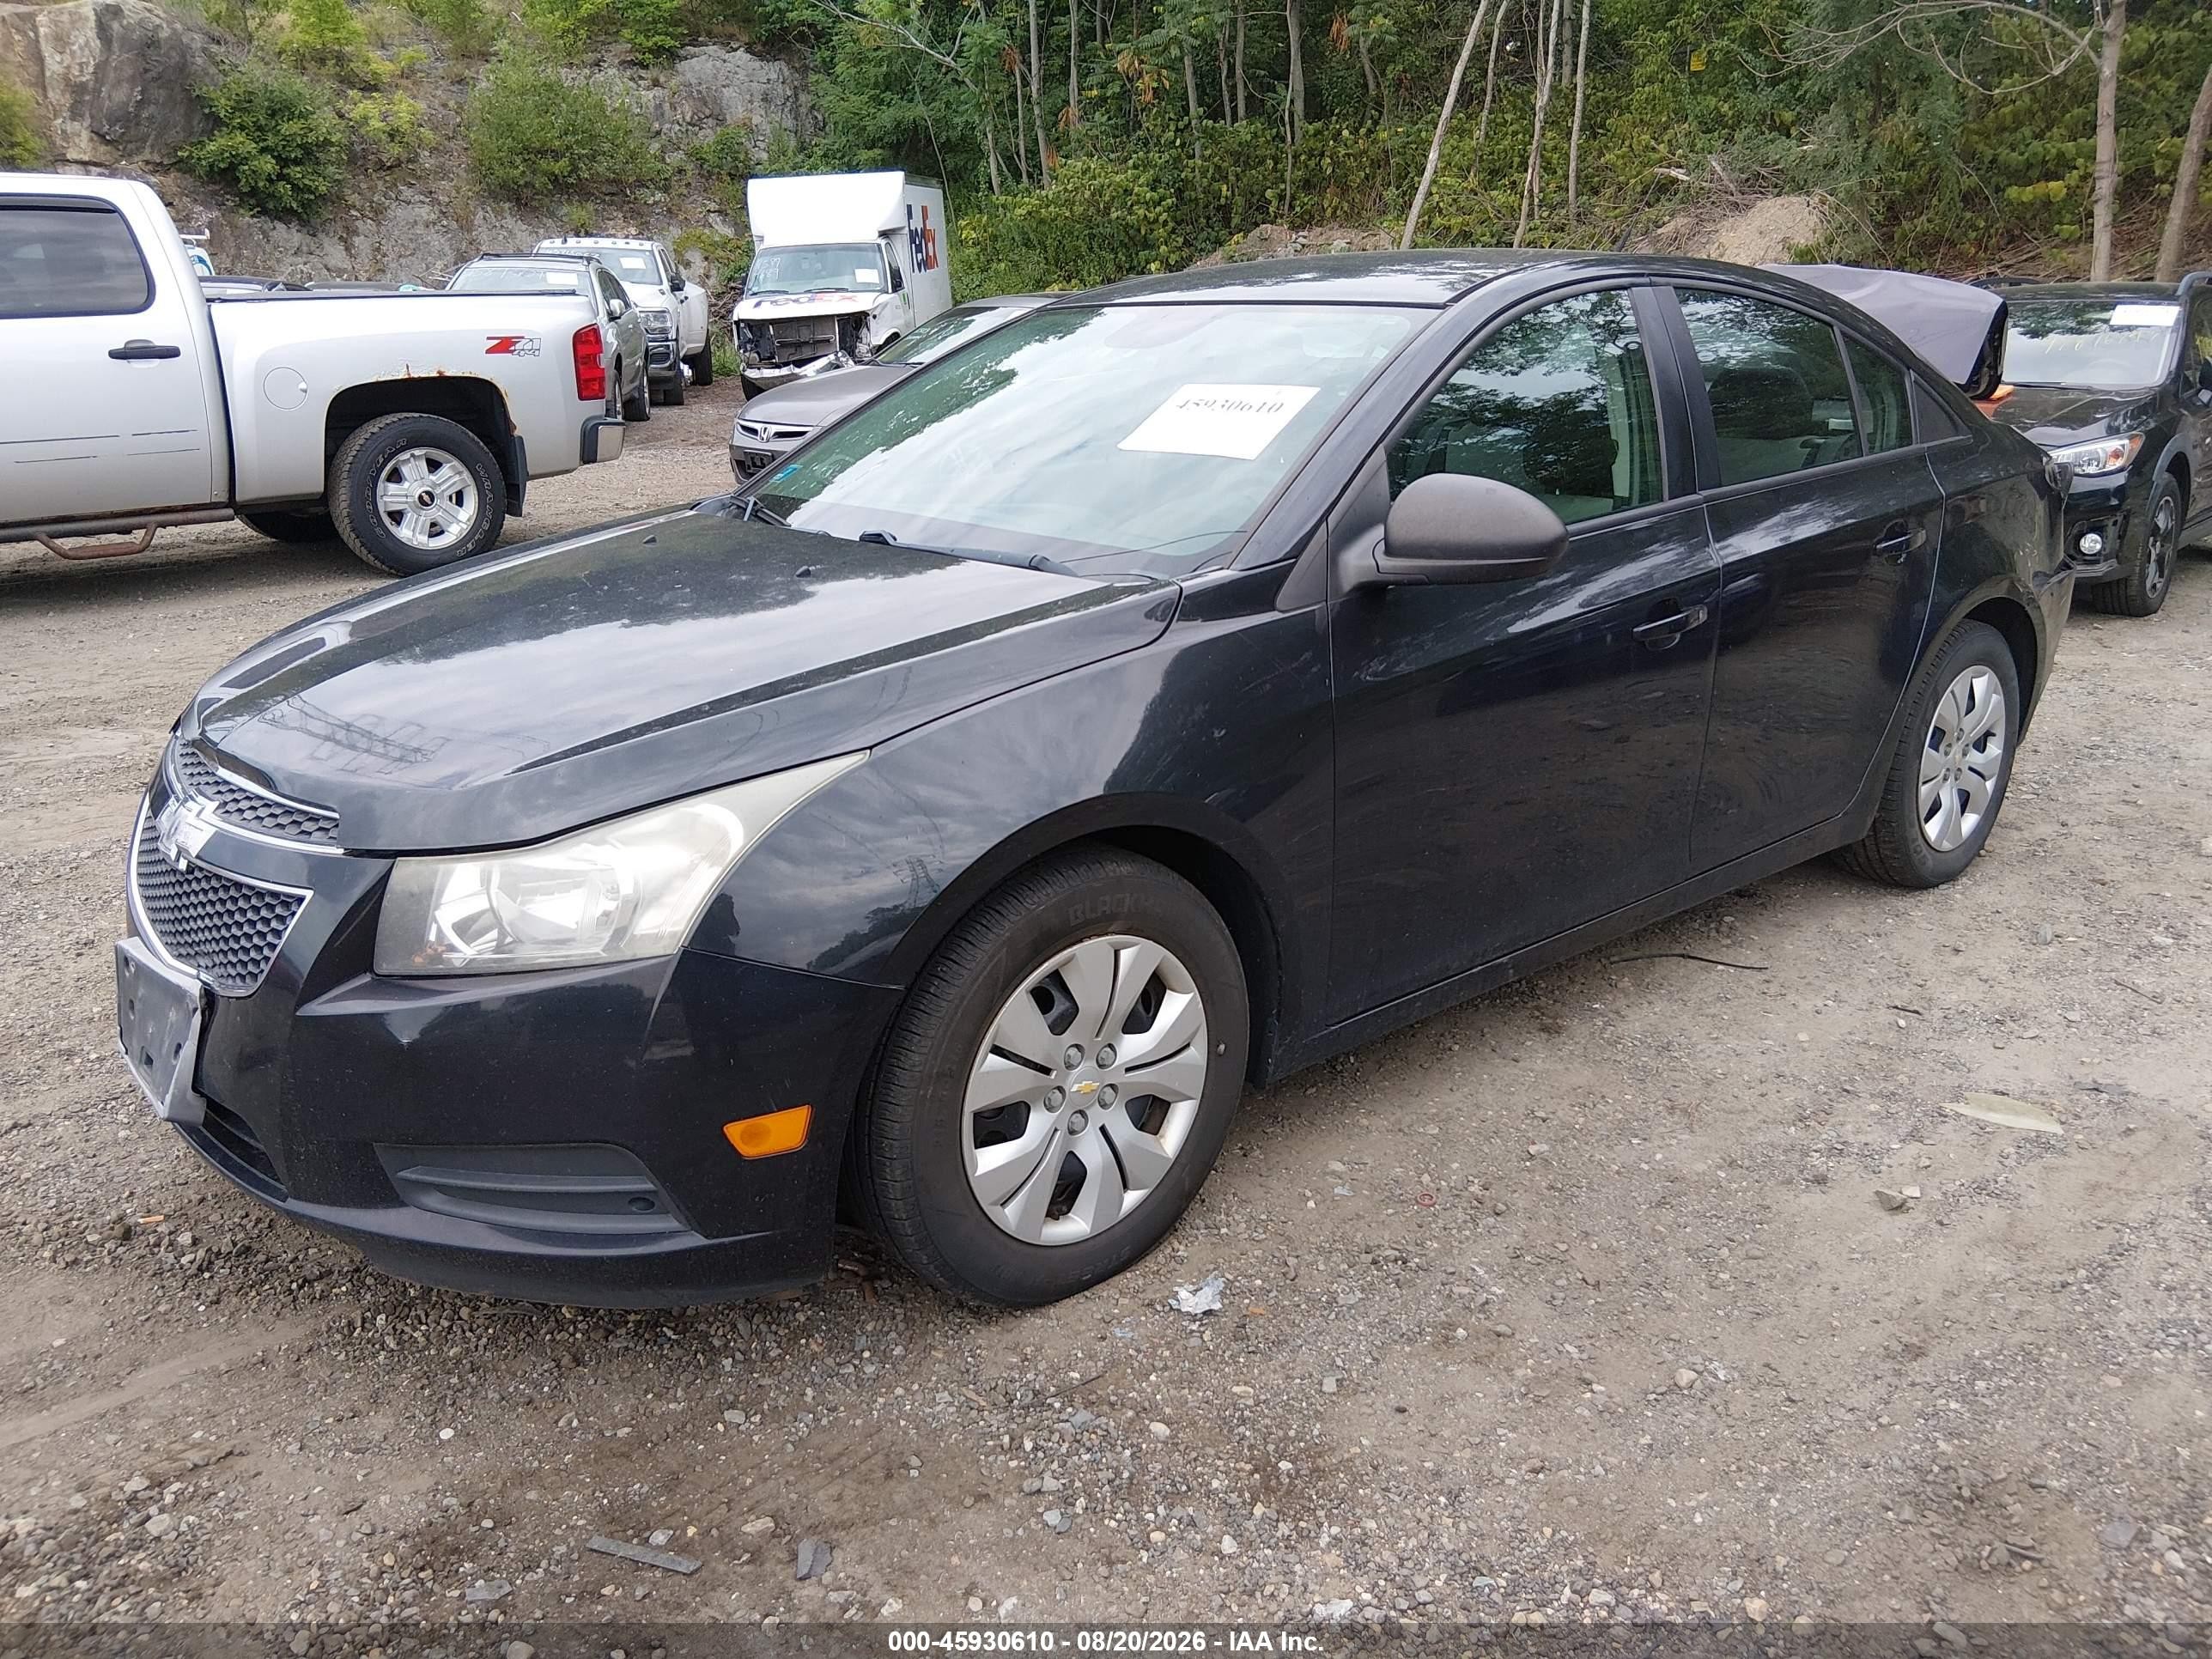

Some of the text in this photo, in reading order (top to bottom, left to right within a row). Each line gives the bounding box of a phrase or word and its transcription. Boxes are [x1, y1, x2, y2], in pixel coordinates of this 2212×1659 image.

[907, 204, 939, 275] FedEx
[753, 292, 860, 309] FedEx
[485, 336, 542, 355] Z71
[363, 438, 408, 539] GOODYEAR
[456, 462, 495, 558] WRANGLER
